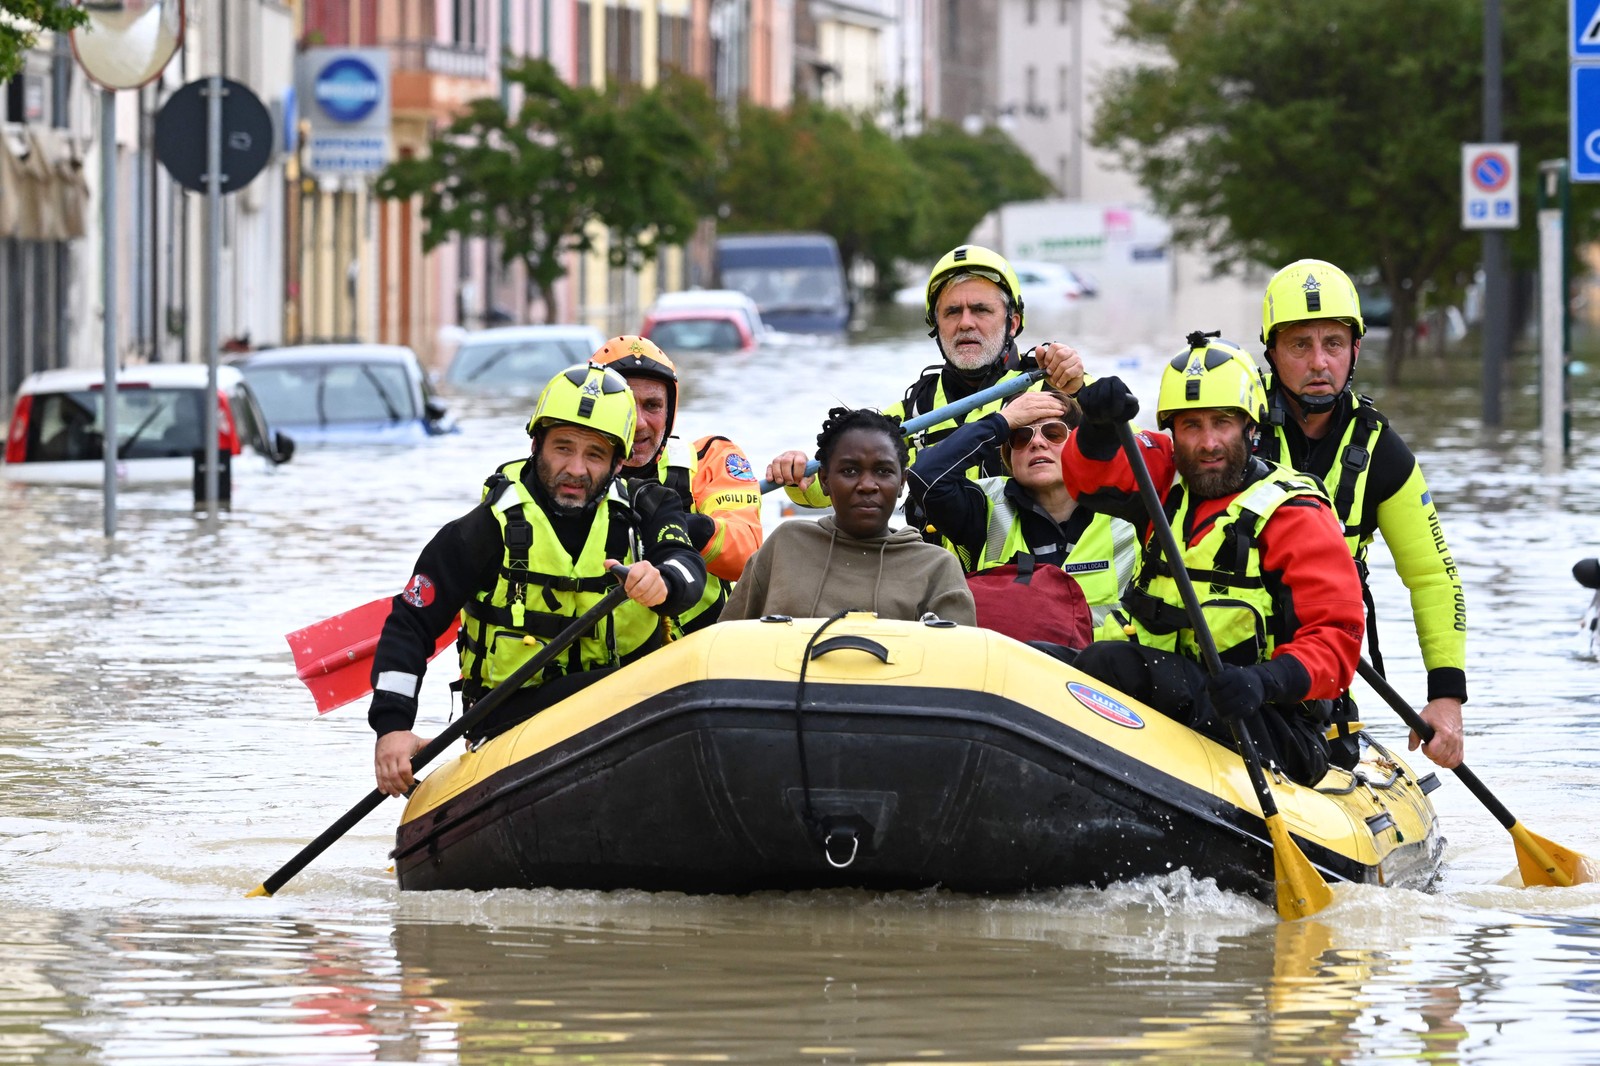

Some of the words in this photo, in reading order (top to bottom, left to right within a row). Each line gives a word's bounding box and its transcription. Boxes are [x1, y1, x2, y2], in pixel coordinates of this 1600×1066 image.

[716, 494, 743, 505] VIGILI
[746, 493, 762, 504] DE
[1087, 561, 1107, 570] LOCALE
[1428, 511, 1448, 554] VIGILI
[1442, 556, 1459, 581] DEL
[1453, 584, 1467, 632] FUOCO
